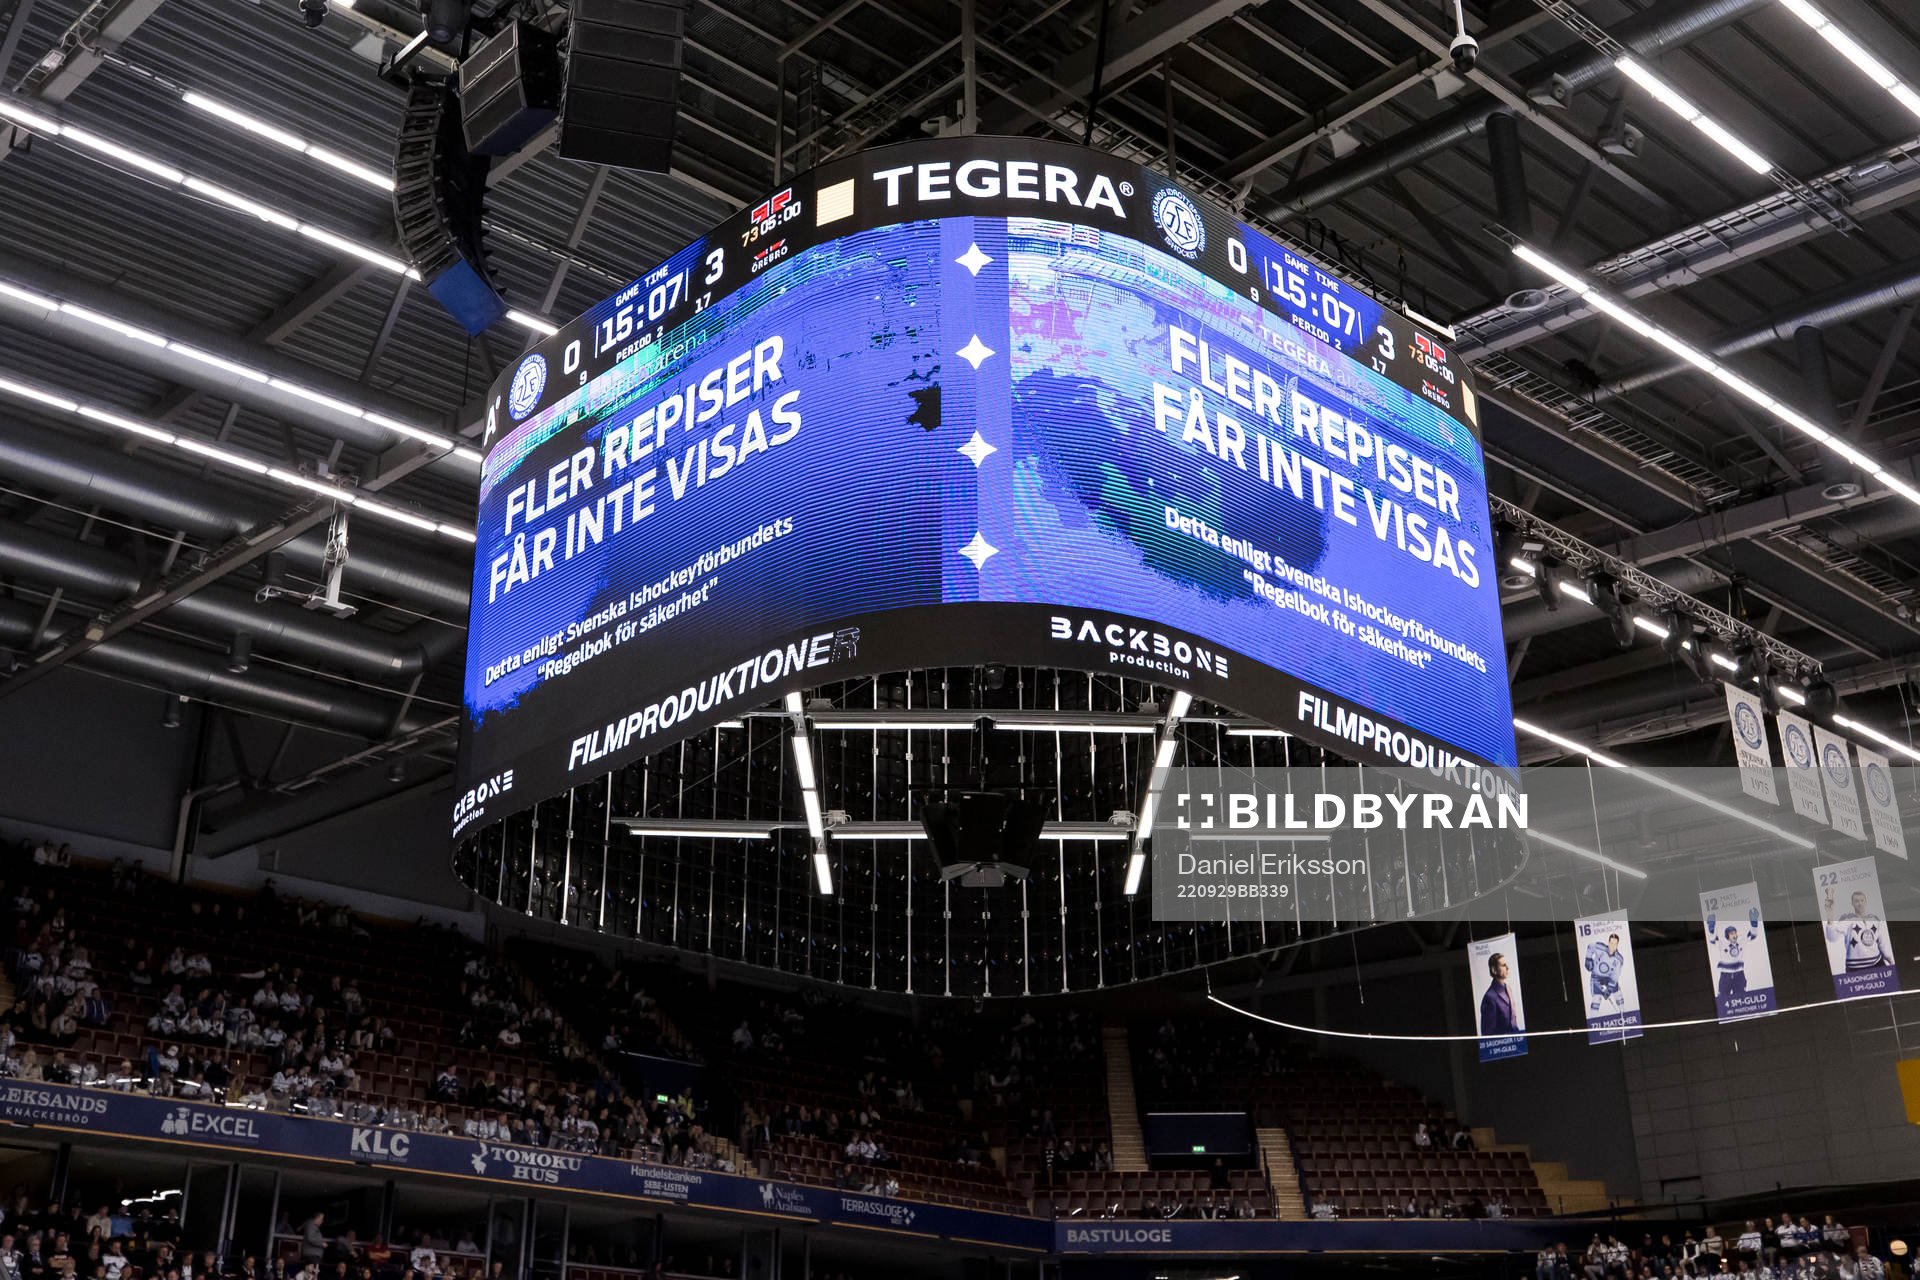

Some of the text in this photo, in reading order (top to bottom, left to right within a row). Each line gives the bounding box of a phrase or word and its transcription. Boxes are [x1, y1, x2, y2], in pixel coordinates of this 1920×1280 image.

[741, 201, 801, 248] 73 05:00
[705, 247, 724, 285] 3
[751, 245, 788, 273] ÖREBRO
[1227, 237, 1248, 275] 0
[615, 265, 669, 307] GAME TIME
[1284, 253, 1340, 294] GAME TIME
[694, 292, 712, 314] 17
[1250, 286, 1260, 303] 9
[1271, 261, 1356, 336] 15:07
[600, 272, 684, 353] 15:07
[615, 325, 664, 364] PERIOD 2
[1291, 313, 1342, 351] PERIOD 2
[1376, 325, 1395, 361] 3
[563, 339, 581, 375] 0
[1371, 356, 1387, 375] 17
[1408, 344, 1455, 385] 73 05:00
[579, 370, 588, 386] 9
[504, 446, 596, 537] FLER
[602, 335, 784, 479] REPISER
[1168, 324, 1461, 522] FLER REPISER
[488, 390, 803, 605] FÅR INTE VISAS
[1152, 382, 1248, 472] FÅR
[1257, 433, 1358, 527] INTE
[1361, 486, 1481, 589] VISAS
[484, 516, 794, 687] Detta enligt Svenska Ishockeyförbundets
[1164, 506, 1487, 674] Detta enligt Svenska Ishockeyförbundets
[615, 620, 637, 643] för
[1331, 613, 1357, 637] för
[1050, 616, 1229, 679] BACKBONE
[1109, 651, 1190, 680] production
[1819, 872, 1838, 887] 22
[1704, 898, 1719, 912] 12
[1578, 924, 1592, 937] 16
[1730, 994, 1767, 1007] SM-GULD
[191, 1112, 260, 1138] EXCEL
[351, 1127, 410, 1157] KLC
[491, 1146, 582, 1171] TOMOKU
[512, 1164, 559, 1184] HUS
[630, 1164, 702, 1184] Handelsbanken
[775, 1187, 804, 1202] Naples
[775, 1201, 812, 1215] Arabians
[840, 1198, 902, 1218] TERRASSLOGE
[1067, 1229, 1172, 1243] BASTULOGE
